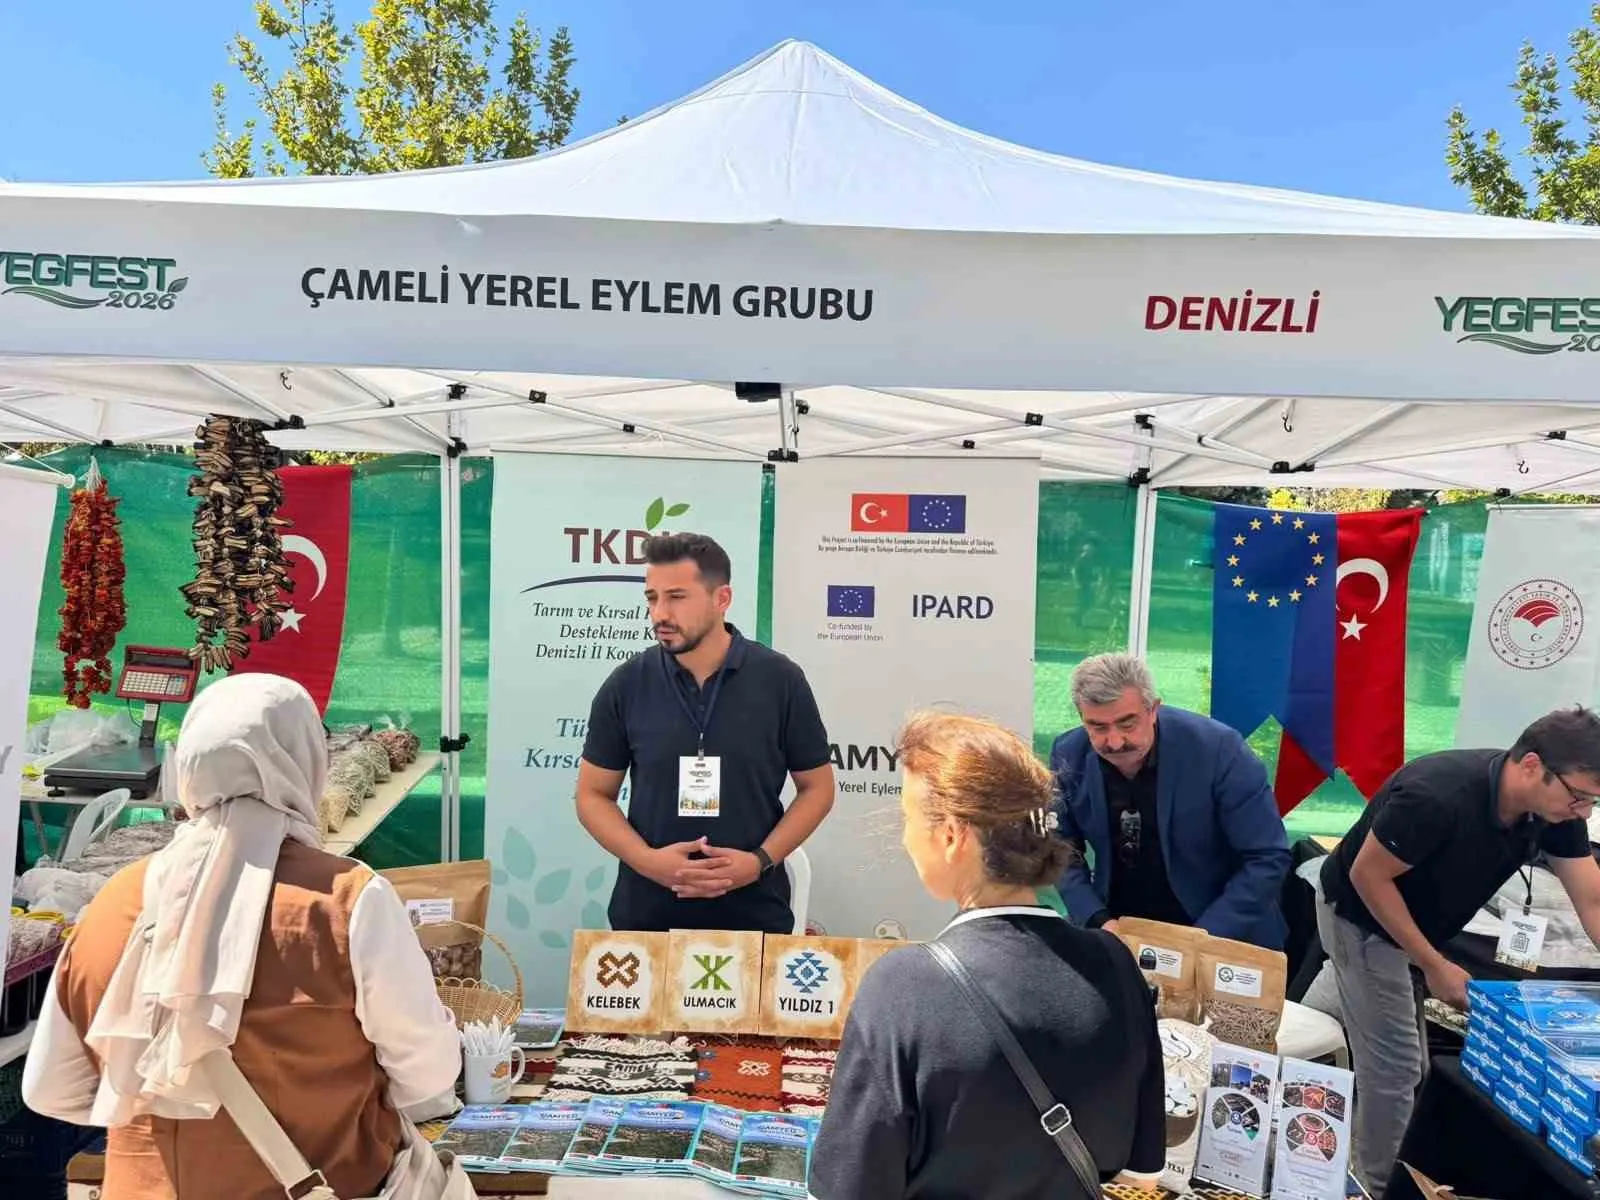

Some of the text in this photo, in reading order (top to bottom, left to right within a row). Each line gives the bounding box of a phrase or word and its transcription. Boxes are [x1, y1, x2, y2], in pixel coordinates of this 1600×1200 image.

[0, 252, 177, 291] EGFEST
[105, 291, 178, 310] 2026
[301, 265, 874, 322] ÇAMELİ YEREL EYLEM GRUBU
[1144, 289, 1321, 333] DENİZLİ
[1434, 296, 1600, 333] YEGFES
[563, 527, 670, 565] TKD
[533, 602, 573, 618] Tarım
[578, 607, 593, 618] ve
[598, 605, 641, 620] Kırsal
[912, 594, 994, 620] IPARD
[559, 624, 639, 640] Destekleme
[535, 643, 586, 659] Denizli
[839, 781, 867, 793] Yerel
[586, 995, 641, 1010] KELEBEK
[683, 996, 737, 1009] ULMACIK
[779, 996, 834, 1014] YILDIZ 1
